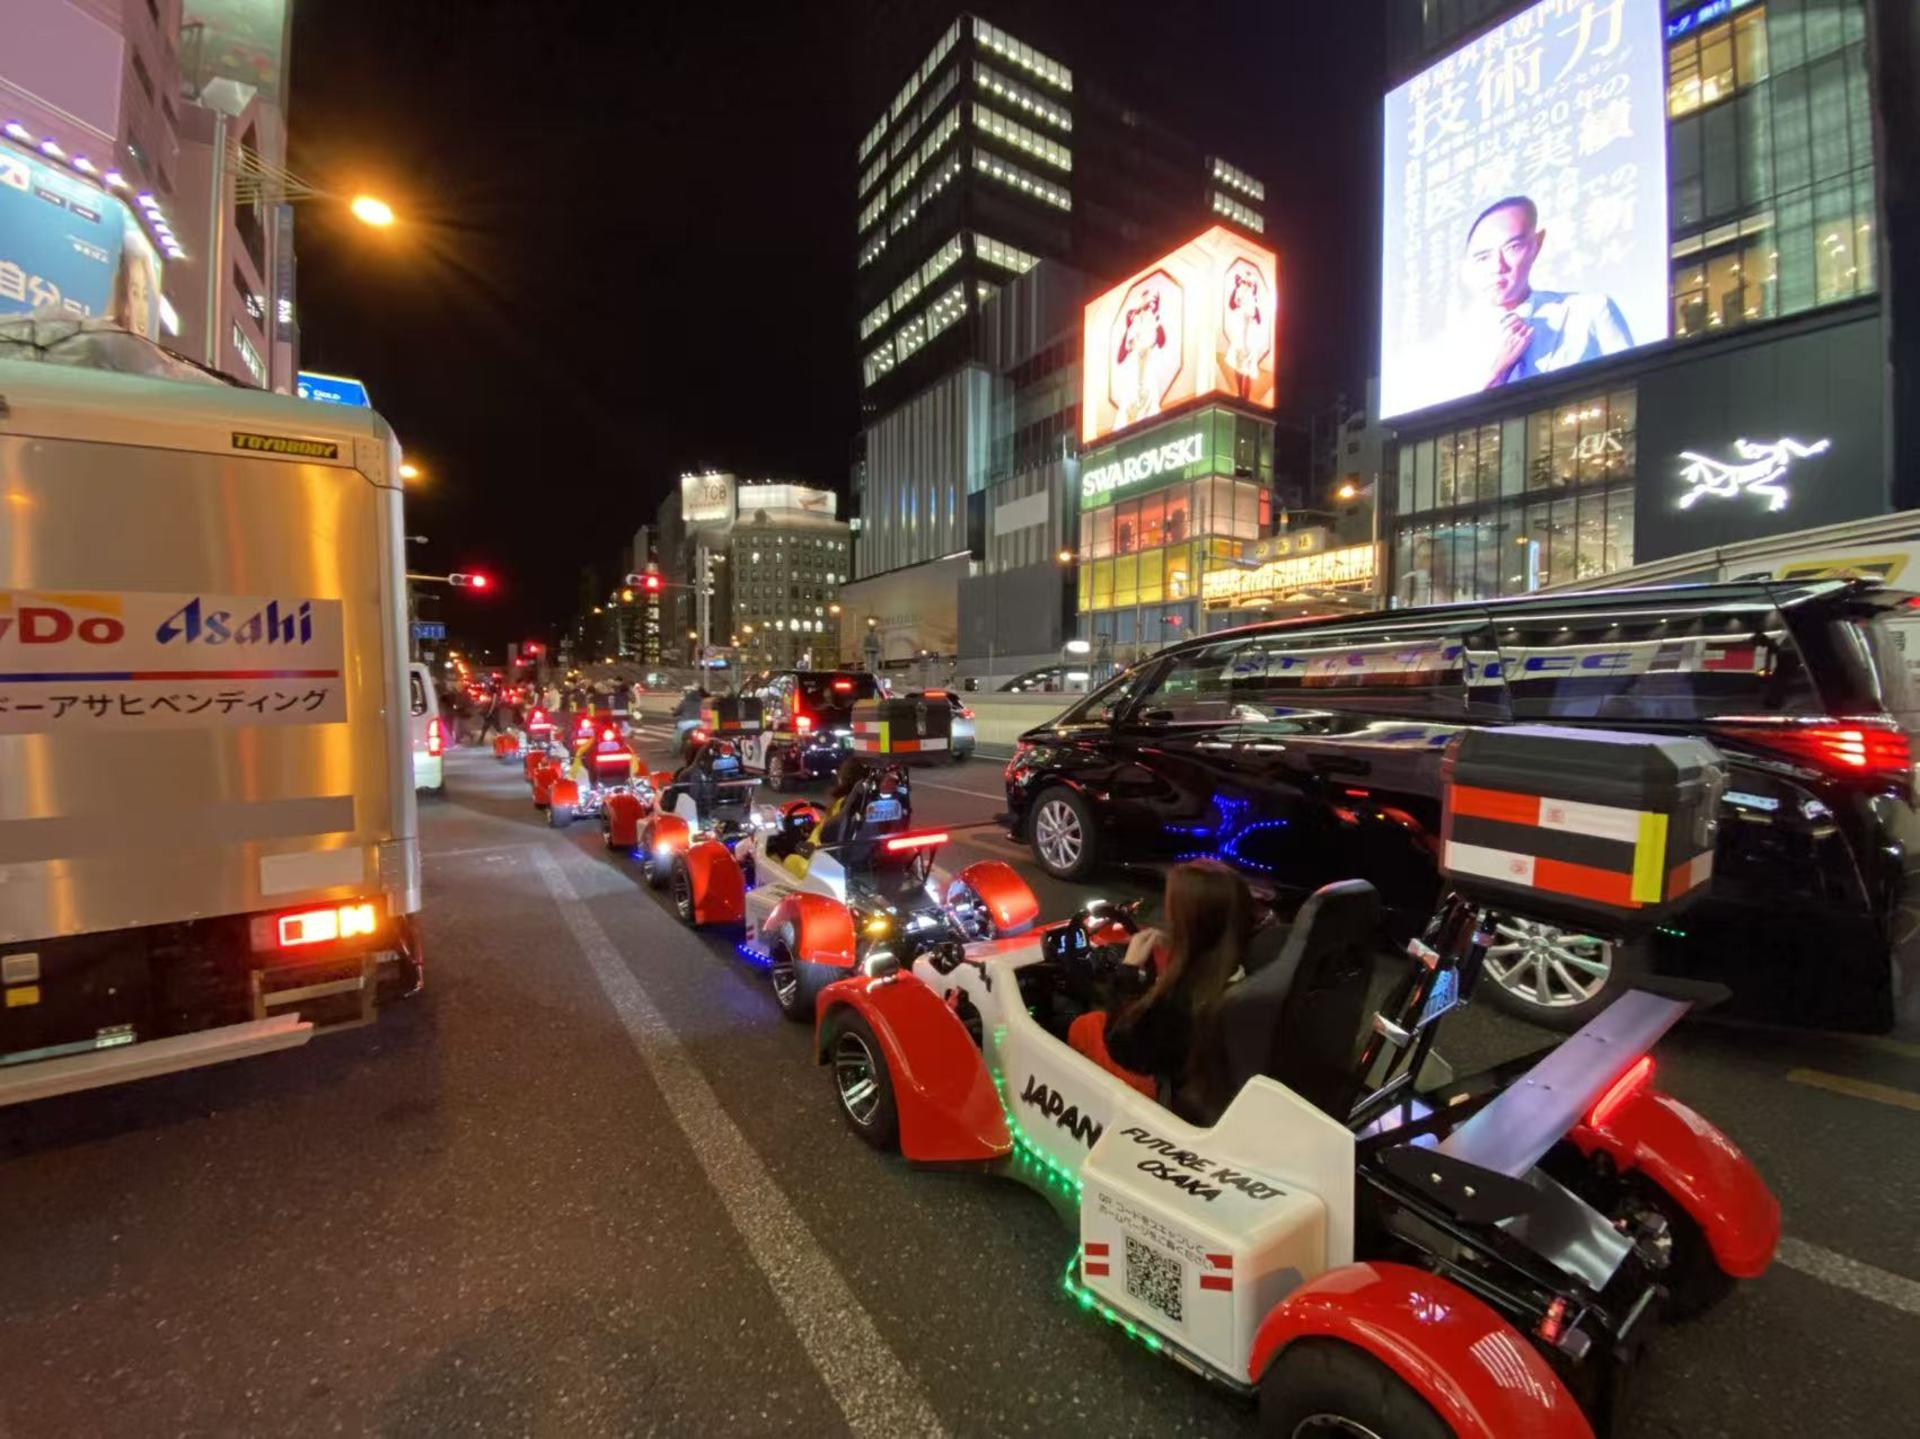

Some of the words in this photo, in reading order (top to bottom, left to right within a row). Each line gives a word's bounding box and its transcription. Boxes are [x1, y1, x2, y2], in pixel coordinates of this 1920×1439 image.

[1408, 0, 1625, 157] 技術力
[1082, 433, 1203, 496] SWAROVSKI
[156, 596, 311, 645] Asahi
[0, 689, 328, 718] ーアサヒベンディング
[1020, 1074, 1103, 1150] JAPAN
[1120, 1127, 1216, 1172] FUTURE
[1210, 1168, 1287, 1200] KART
[1137, 1160, 1222, 1201] OSAKA
